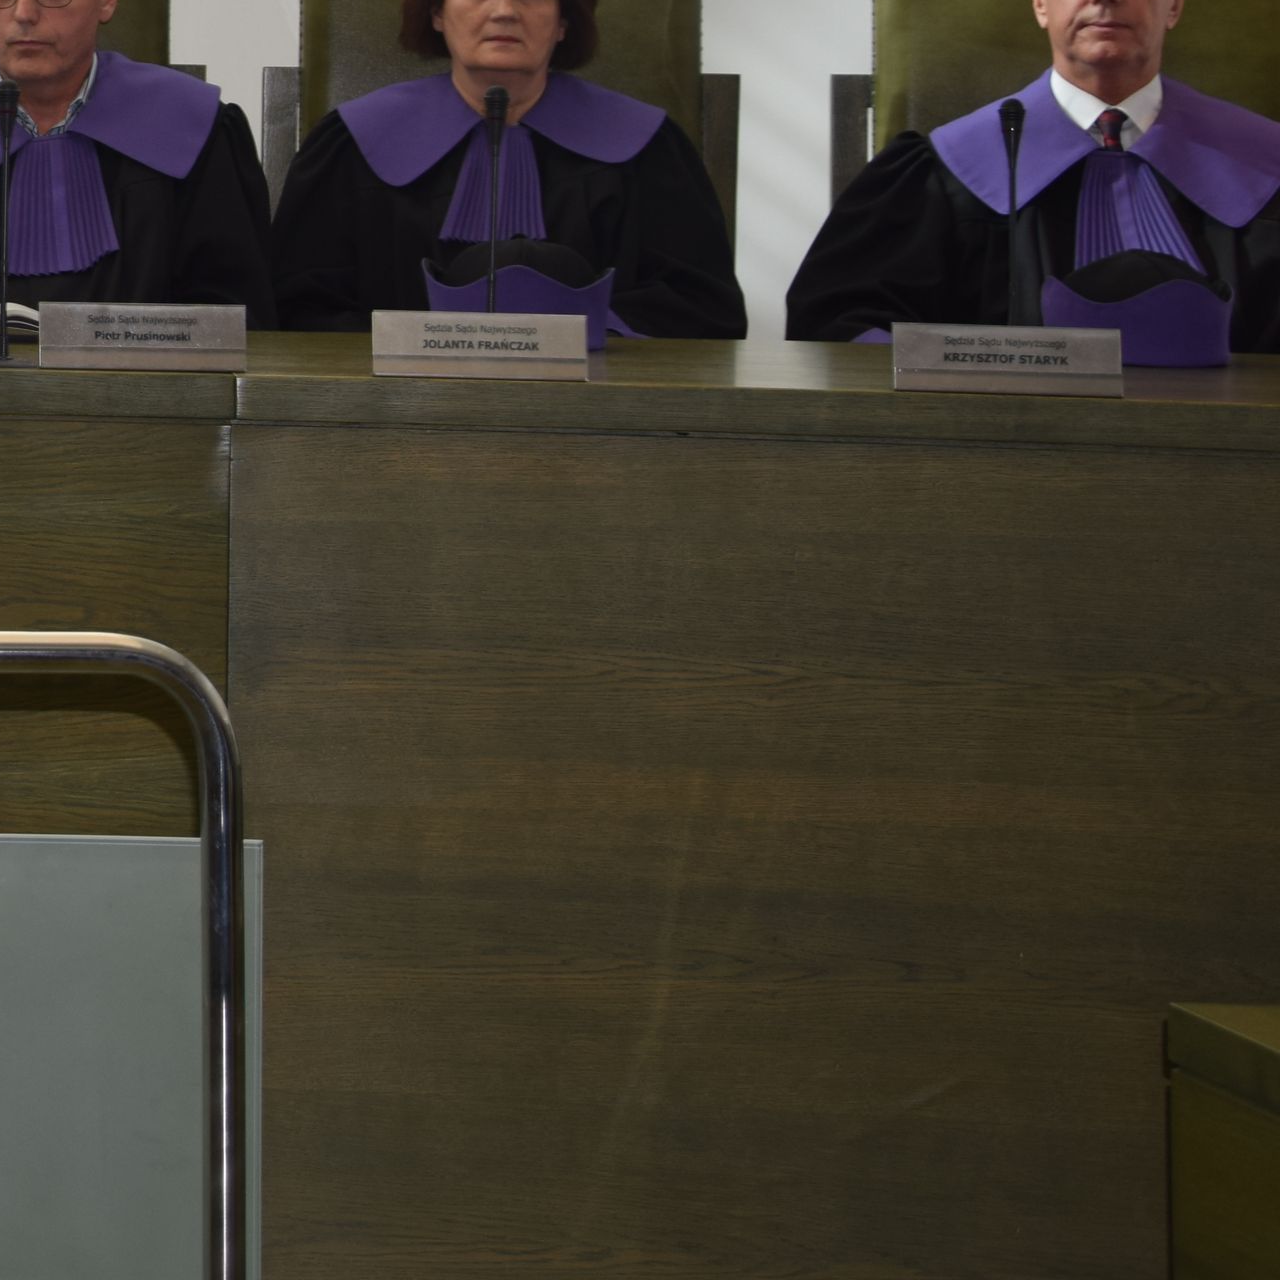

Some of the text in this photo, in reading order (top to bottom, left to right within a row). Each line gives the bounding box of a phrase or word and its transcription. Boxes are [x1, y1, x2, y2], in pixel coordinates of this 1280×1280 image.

[95, 331, 190, 341] Piotr Prusinowski
[423, 339, 539, 351] JOLANTA FRAŃCZAK
[944, 353, 1068, 365] KRZYSZTOF STARYK
